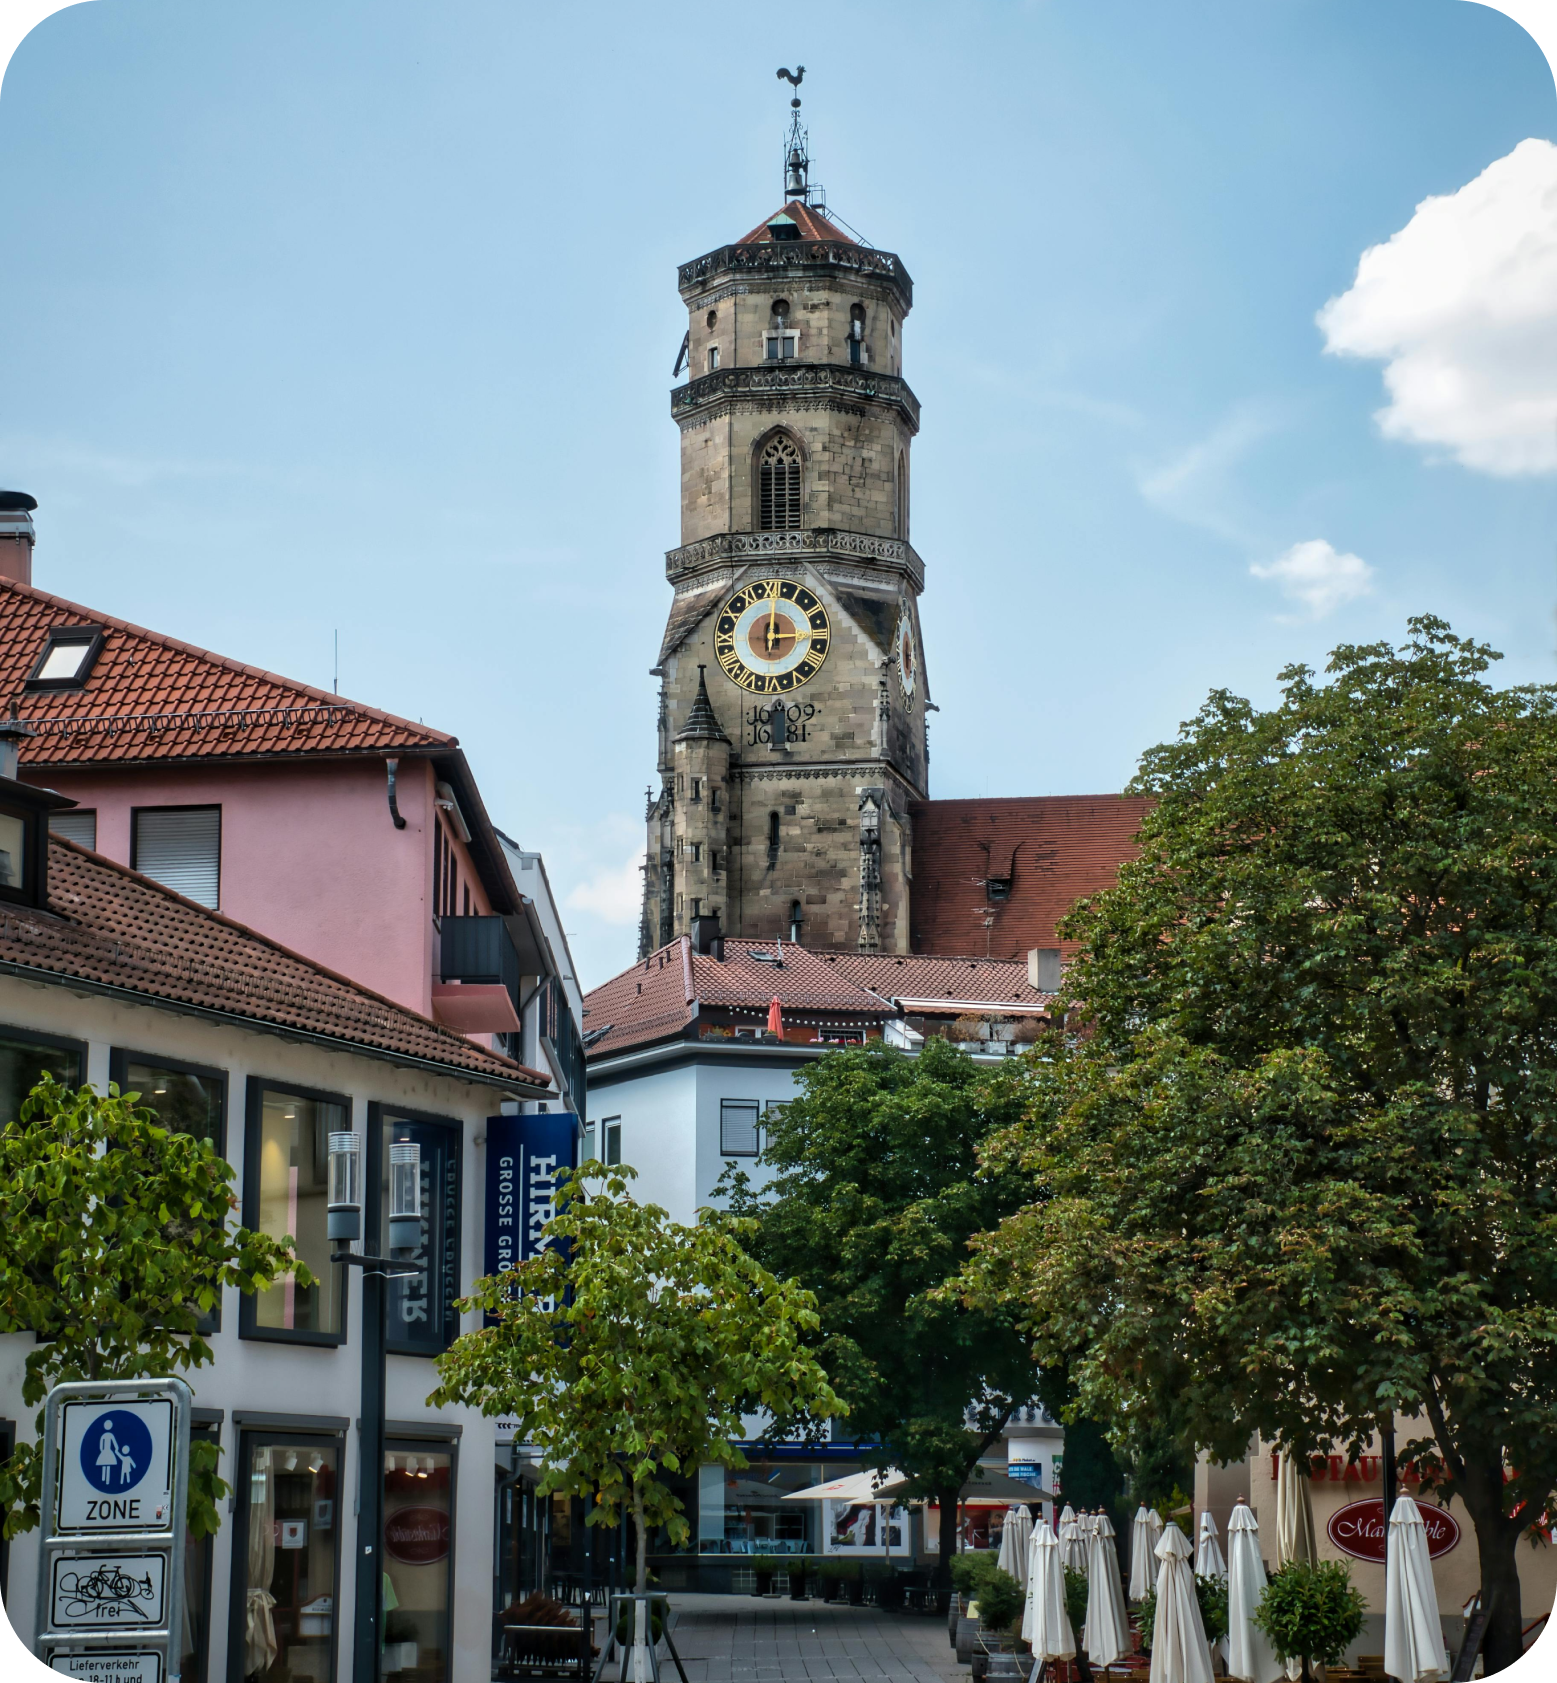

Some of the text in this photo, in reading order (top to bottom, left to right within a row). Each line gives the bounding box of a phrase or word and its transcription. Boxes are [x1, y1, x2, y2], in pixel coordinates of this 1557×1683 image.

[739, 586, 757, 607] XI
[724, 606, 740, 622] X
[806, 603, 822, 618] II
[812, 628, 828, 640] III
[792, 670, 806, 686] V
[498, 1156, 514, 1226] GROSSE
[86, 1500, 141, 1520] ZONE
[96, 1602, 120, 1618] frei
[70, 1659, 140, 1671] Lieferverkehr
[124, 1674, 142, 1683] und
